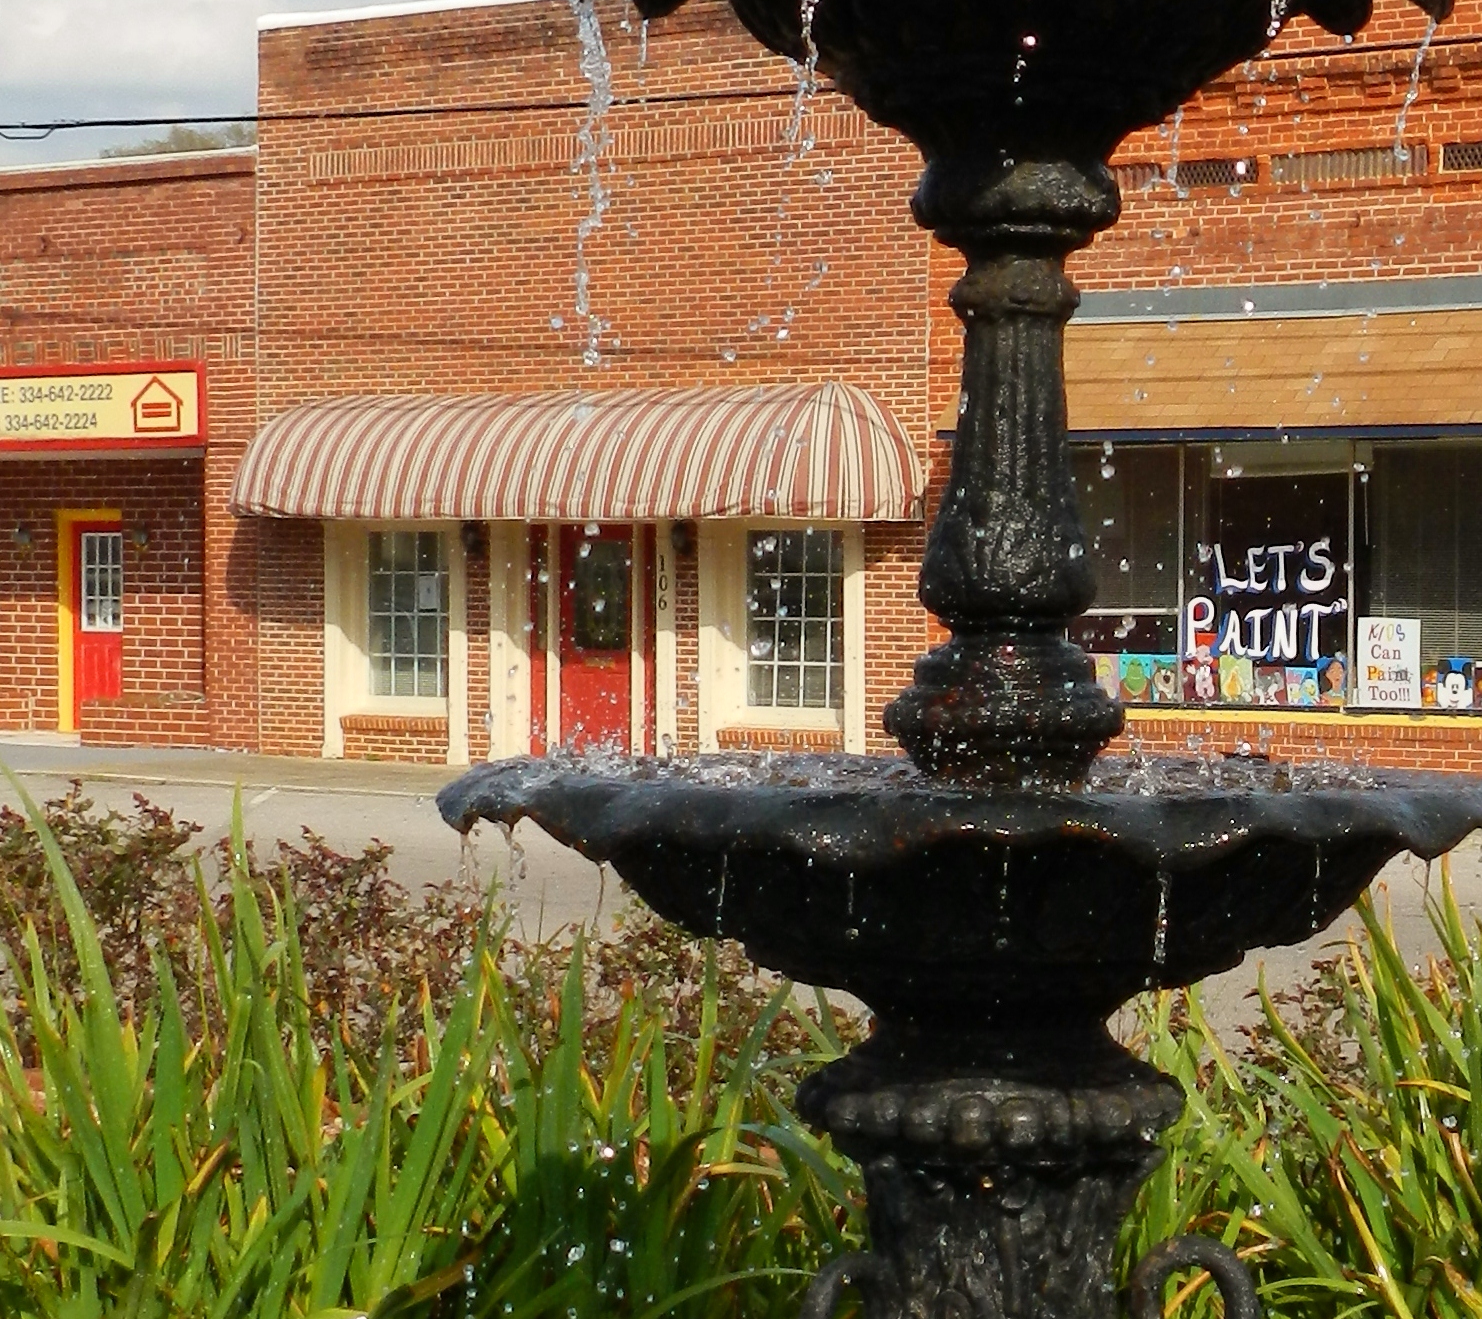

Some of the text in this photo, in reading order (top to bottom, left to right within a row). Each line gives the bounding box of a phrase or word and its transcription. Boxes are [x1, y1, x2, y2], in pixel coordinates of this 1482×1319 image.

[0, 384, 113, 404] E: 334-642-2222
[5, 412, 97, 432] 334-642-2224
[659, 554, 668, 611] 106
[1371, 644, 1402, 660] Can
[1367, 665, 1409, 683] Paint
[1368, 685, 1411, 702] Too!!!
